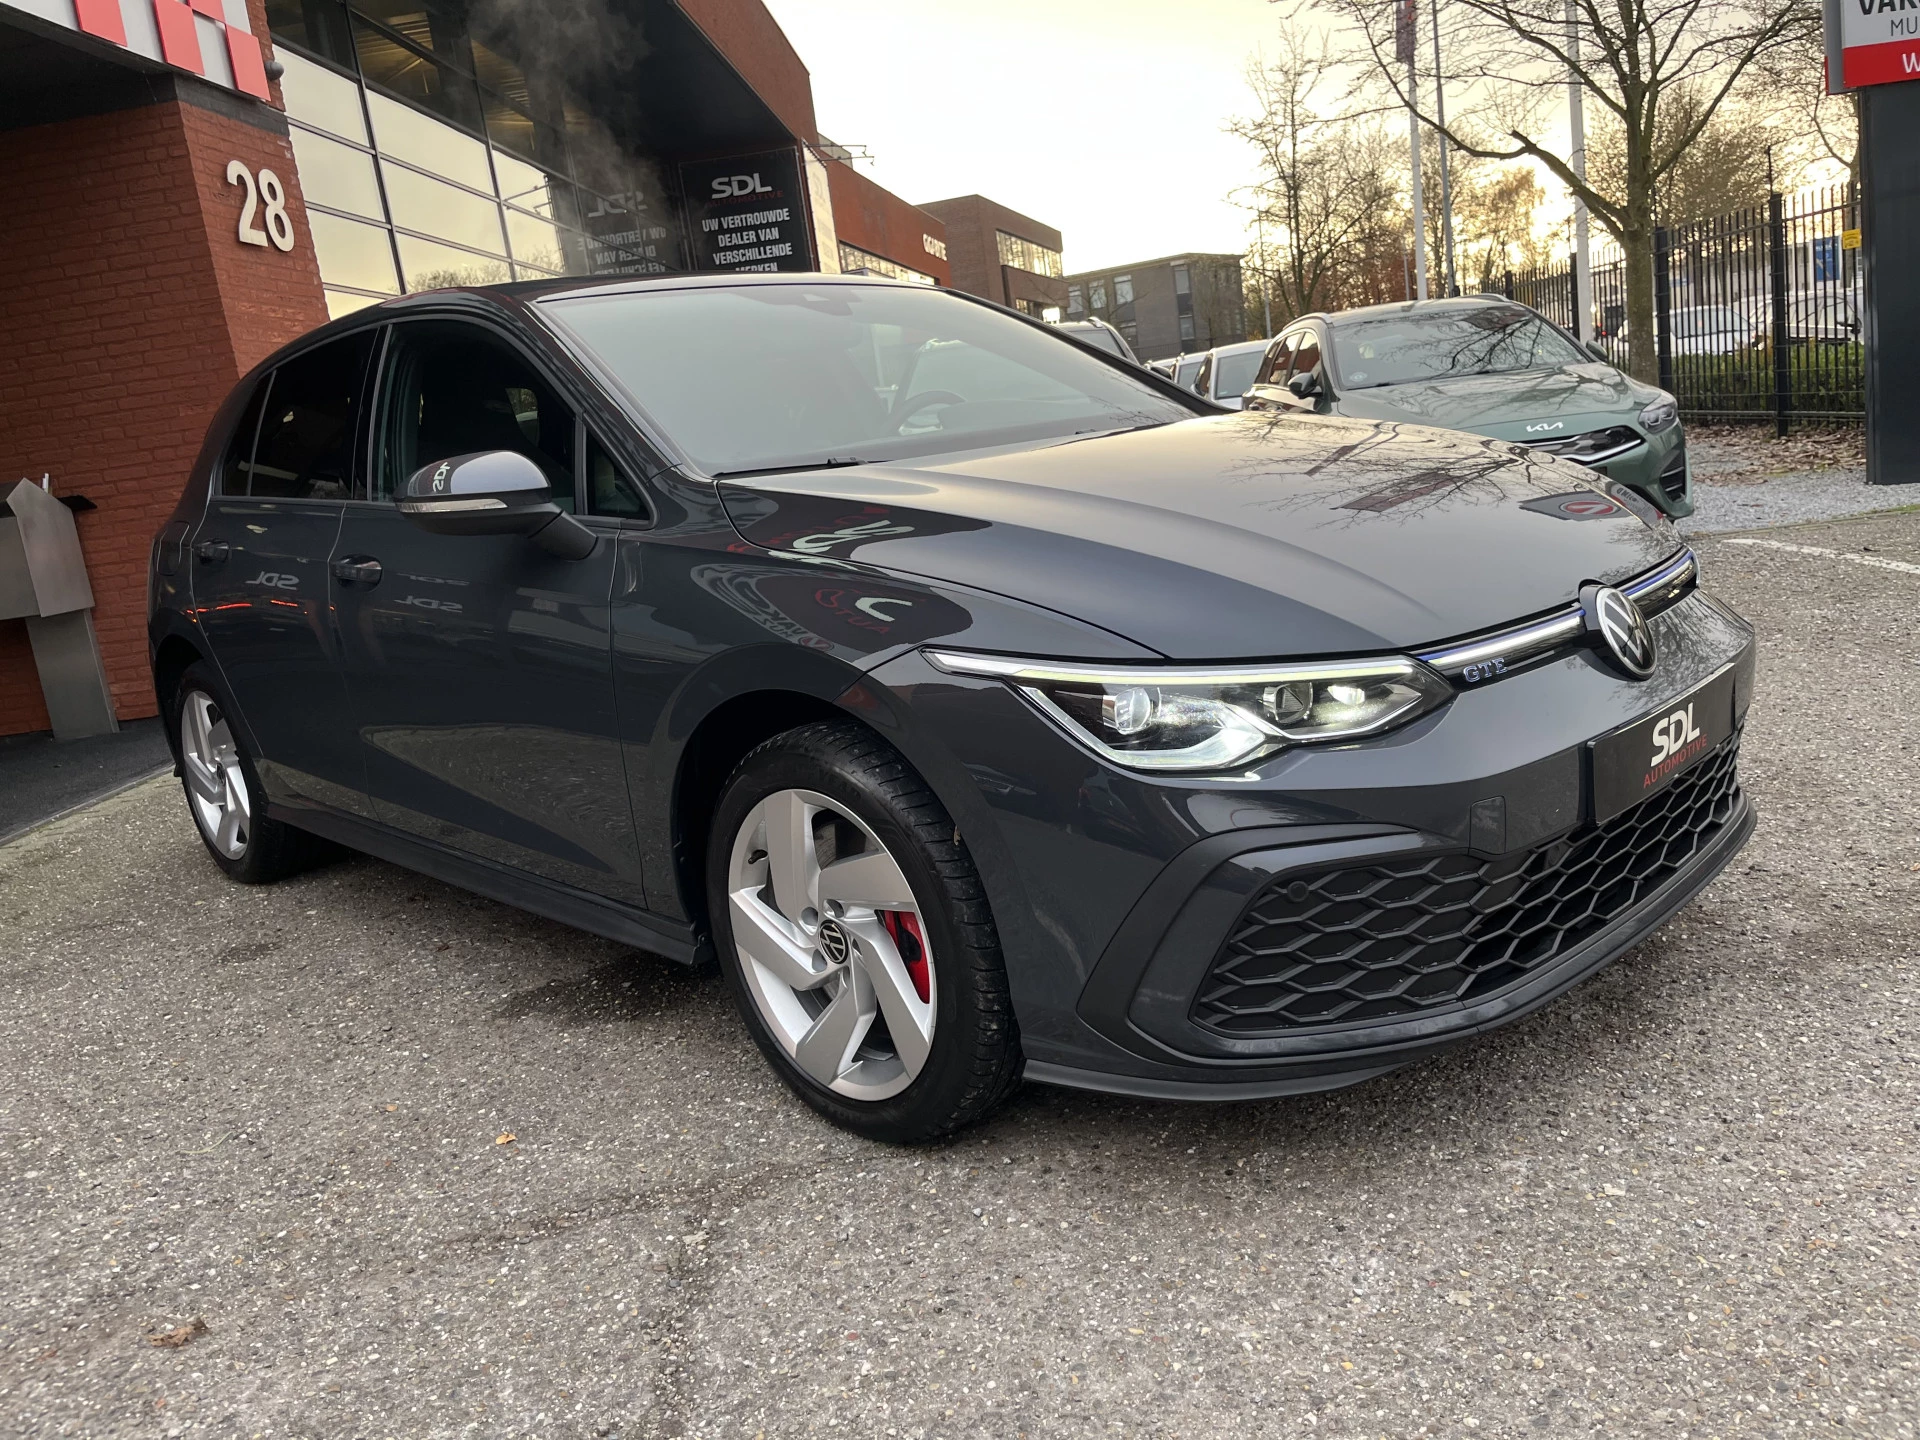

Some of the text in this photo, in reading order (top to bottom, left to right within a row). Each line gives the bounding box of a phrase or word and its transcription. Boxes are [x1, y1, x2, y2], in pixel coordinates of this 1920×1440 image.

[711, 172, 773, 199] SDL
[226, 159, 295, 252] 28
[701, 207, 791, 232] UW VERTROUWDE
[717, 226, 780, 248] DEALER VAN
[712, 242, 793, 266] VERSCHILLENDE
[1526, 421, 1564, 433] KIA
[1463, 657, 1508, 683] GTE
[1650, 702, 1700, 768] SDL
[1643, 734, 1708, 789] AUTOMOTIVE
